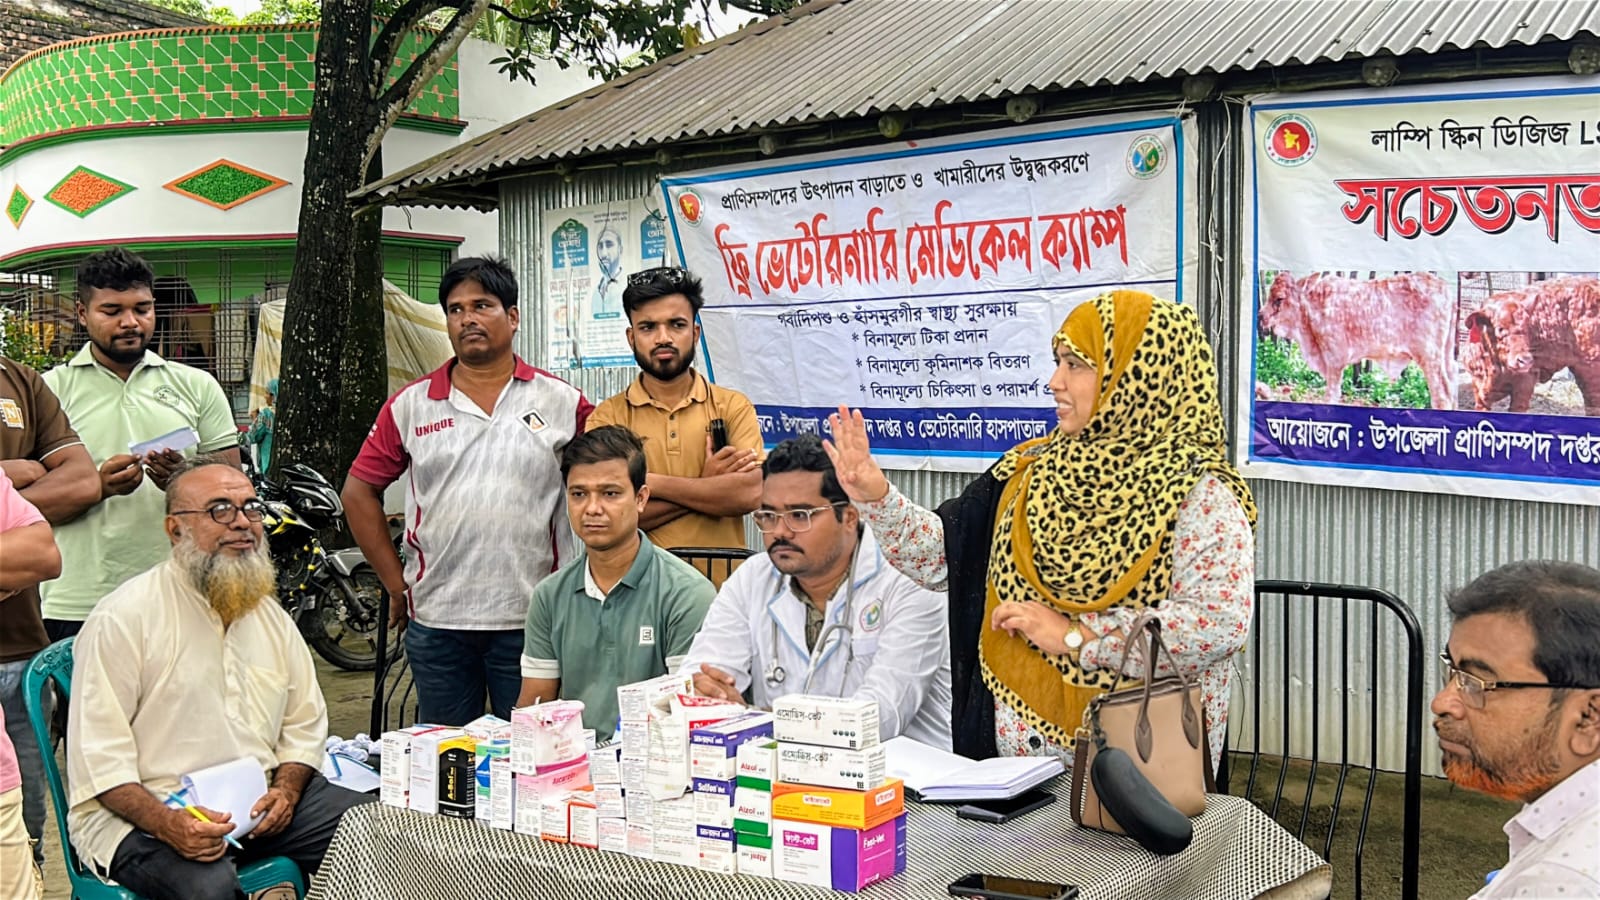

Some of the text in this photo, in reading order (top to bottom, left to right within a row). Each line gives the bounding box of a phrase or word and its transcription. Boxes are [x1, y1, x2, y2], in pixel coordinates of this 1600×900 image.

[1371, 115, 1600, 151] লাম্পি স্কিন ডিজিজ L
[721, 187, 797, 212] প্রাণিসম্পদের
[800, 180, 854, 201] উৎপাদন
[858, 173, 906, 198] বাড়াতে
[911, 172, 924, 189] ও
[934, 159, 1005, 188] খামারীদের
[714, 223, 753, 300] ফ্রি
[755, 206, 899, 295] ভেটেরিনারি
[905, 200, 1033, 285] মেডিকেল
[1037, 204, 1128, 274] ক্যাম্প
[778, 309, 832, 328] গবাদিপশু
[854, 305, 922, 326] হাঁসমুরগীর
[965, 301, 1018, 322] সুরক্ষায়
[864, 327, 988, 350] বিনামূল্যে টিকা প্রদান
[867, 351, 1031, 376] বিনামূল্যে কৃমিনাশক বিতরণ
[871, 382, 923, 401] বিনামূল্যে
[928, 381, 976, 398] চিকিৎসা
[996, 378, 1040, 397] পরামর্শ
[919, 411, 982, 440] ভেটেরিনারি
[986, 417, 1048, 440] হাসপাতাল
[1266, 418, 1352, 450] আয়োজনে
[1369, 416, 1451, 456] উপজেলা
[1455, 420, 1554, 463] প্রাণিসম্পদ
